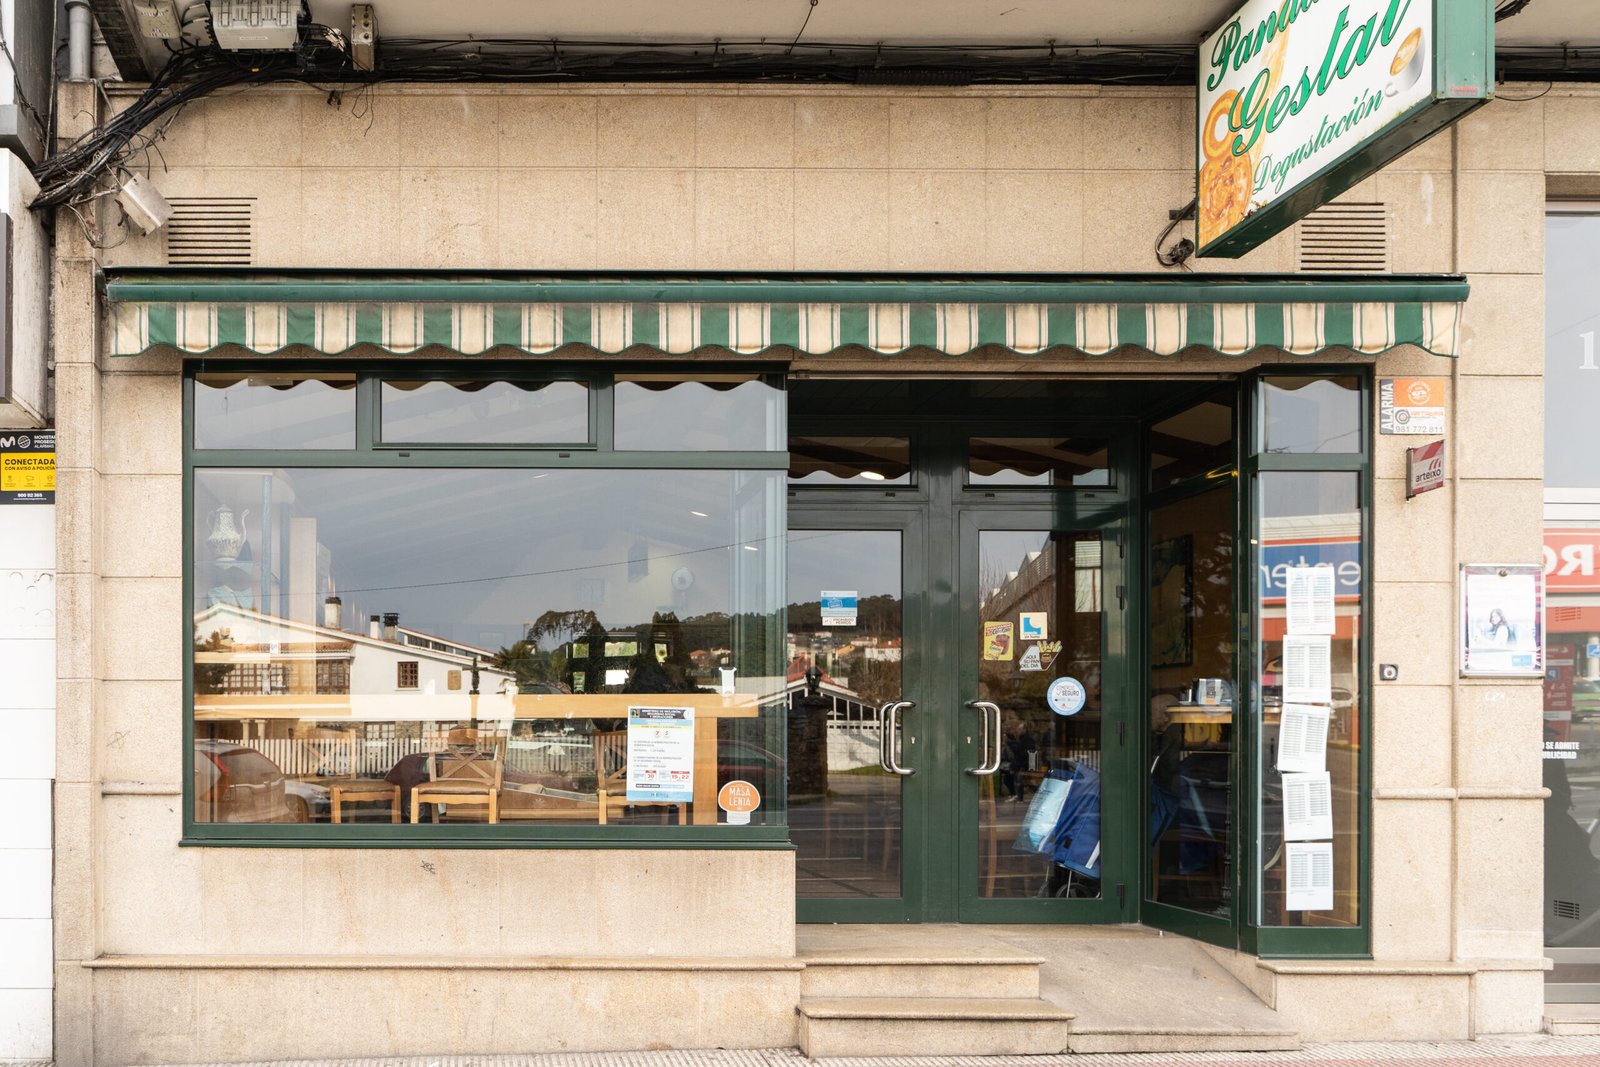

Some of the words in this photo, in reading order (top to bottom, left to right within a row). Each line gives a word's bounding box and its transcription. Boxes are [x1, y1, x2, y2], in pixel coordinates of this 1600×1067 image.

[1252, 88, 1384, 195] Degustación
[1381, 383, 1393, 430] ALARMA
[1415, 468, 1442, 482] arteixo
[1545, 742, 1554, 750] SE
[1554, 742, 1580, 750] ADMITE
[729, 786, 751, 796] MASA
